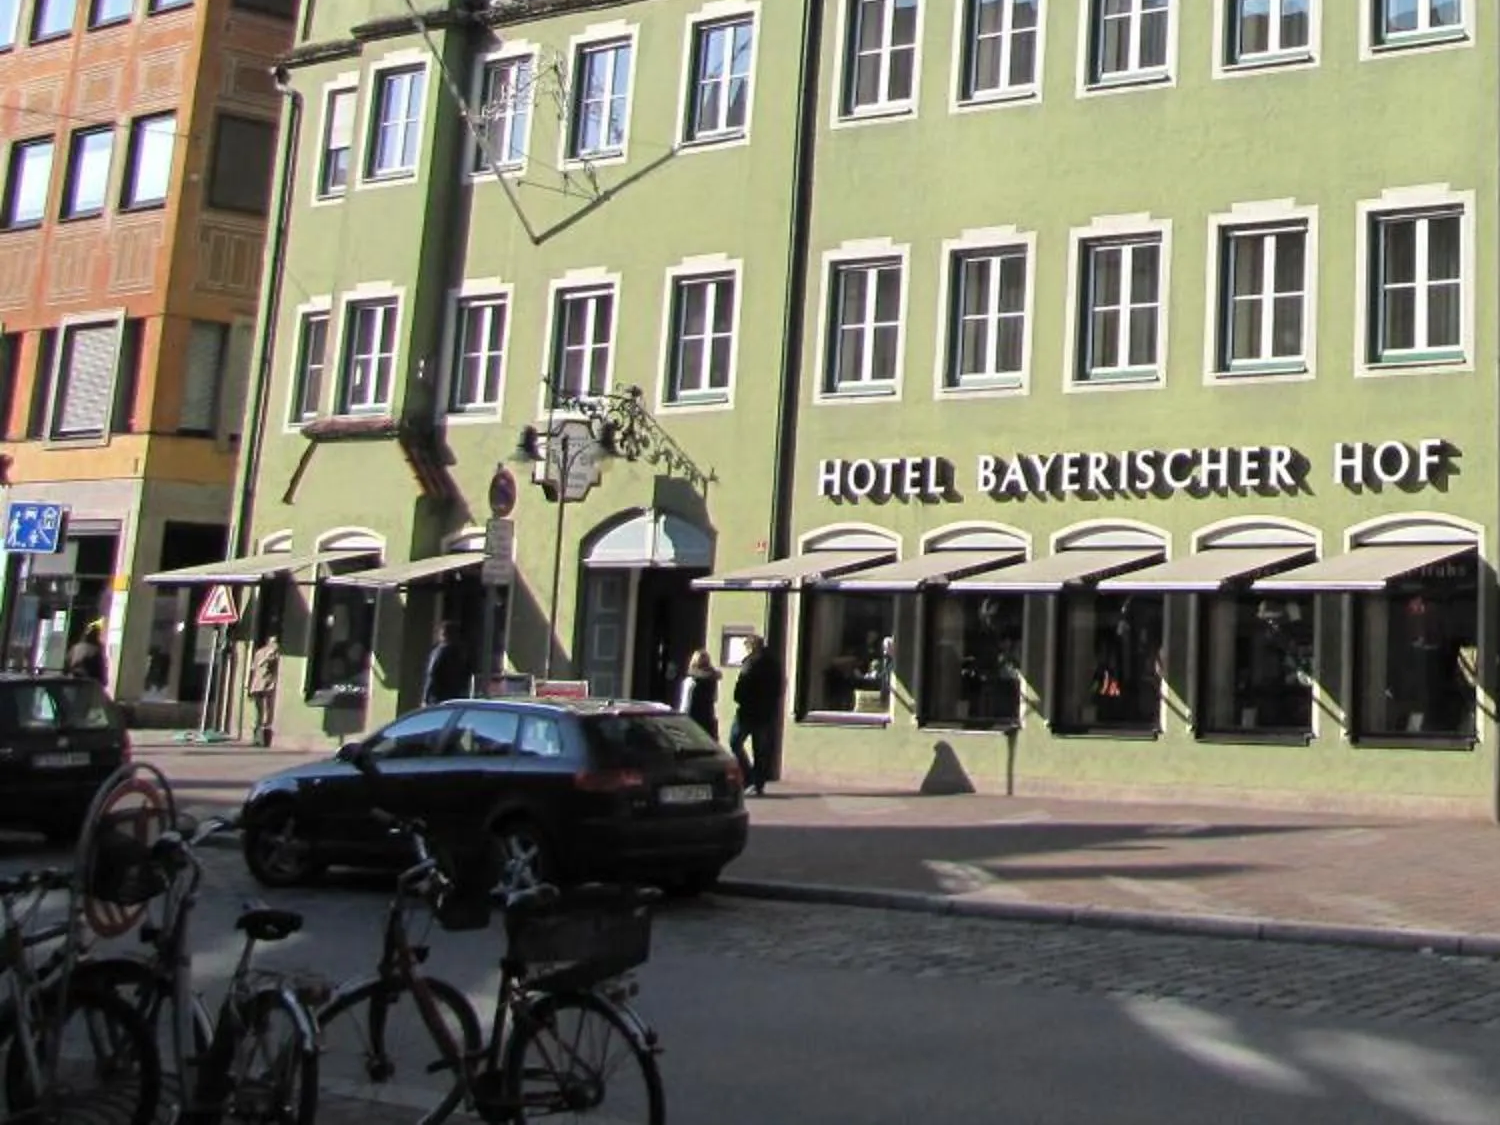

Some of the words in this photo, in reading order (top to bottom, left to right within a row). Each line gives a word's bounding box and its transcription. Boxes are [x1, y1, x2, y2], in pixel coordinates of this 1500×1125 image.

[818, 456, 945, 496] HOTEL
[977, 445, 1296, 492] BAYERISCHER
[1333, 438, 1441, 485] HOF
